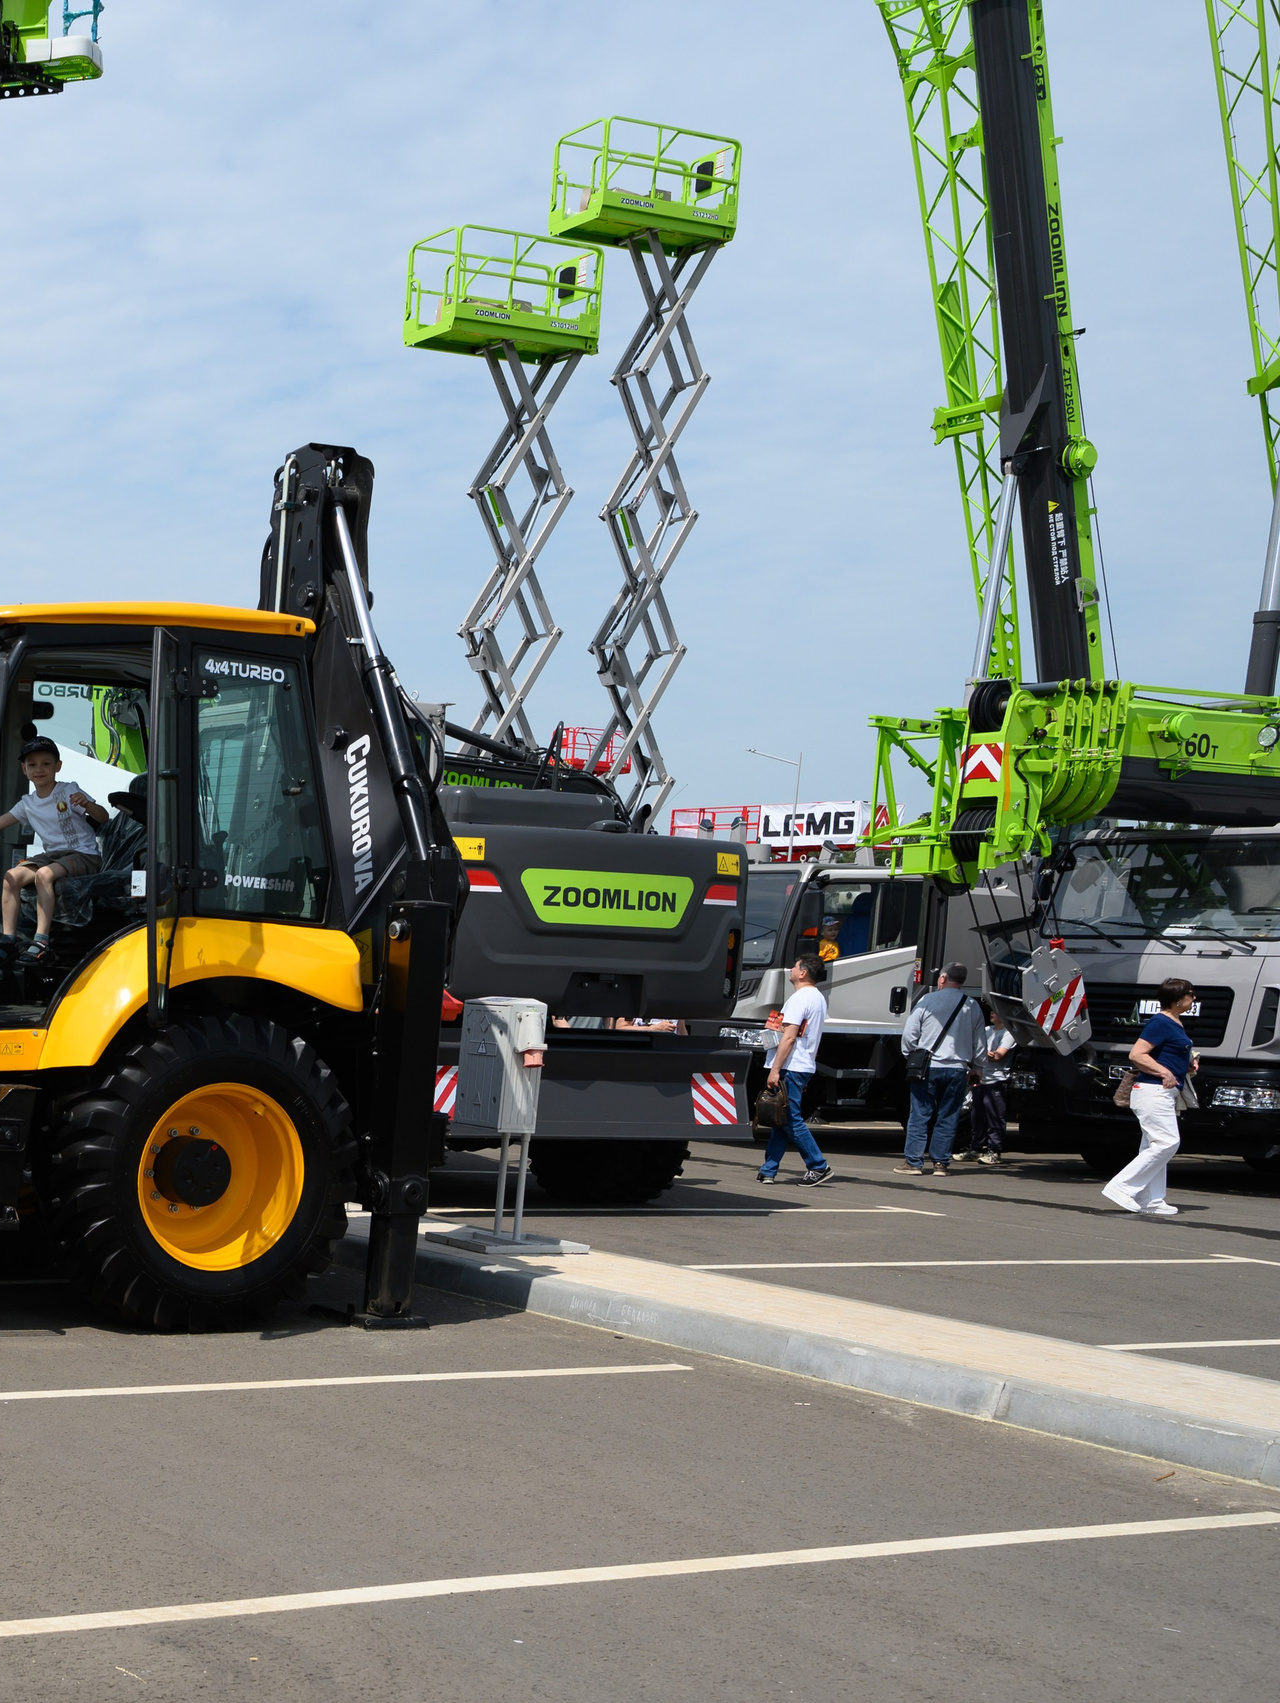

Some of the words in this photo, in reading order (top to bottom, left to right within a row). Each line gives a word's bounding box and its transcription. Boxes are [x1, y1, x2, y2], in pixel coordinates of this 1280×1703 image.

[621, 197, 655, 209] ZOOMLION
[1047, 202, 1069, 318] ZOOMLION
[475, 308, 511, 320] ZOOMLION
[1063, 367, 1076, 423] ZTF250V
[344, 734, 374, 895] ÇUKUROVA
[762, 811, 855, 837] LGMG
[224, 874, 295, 892] POWERShift
[543, 885, 677, 913] ZOOMLION
